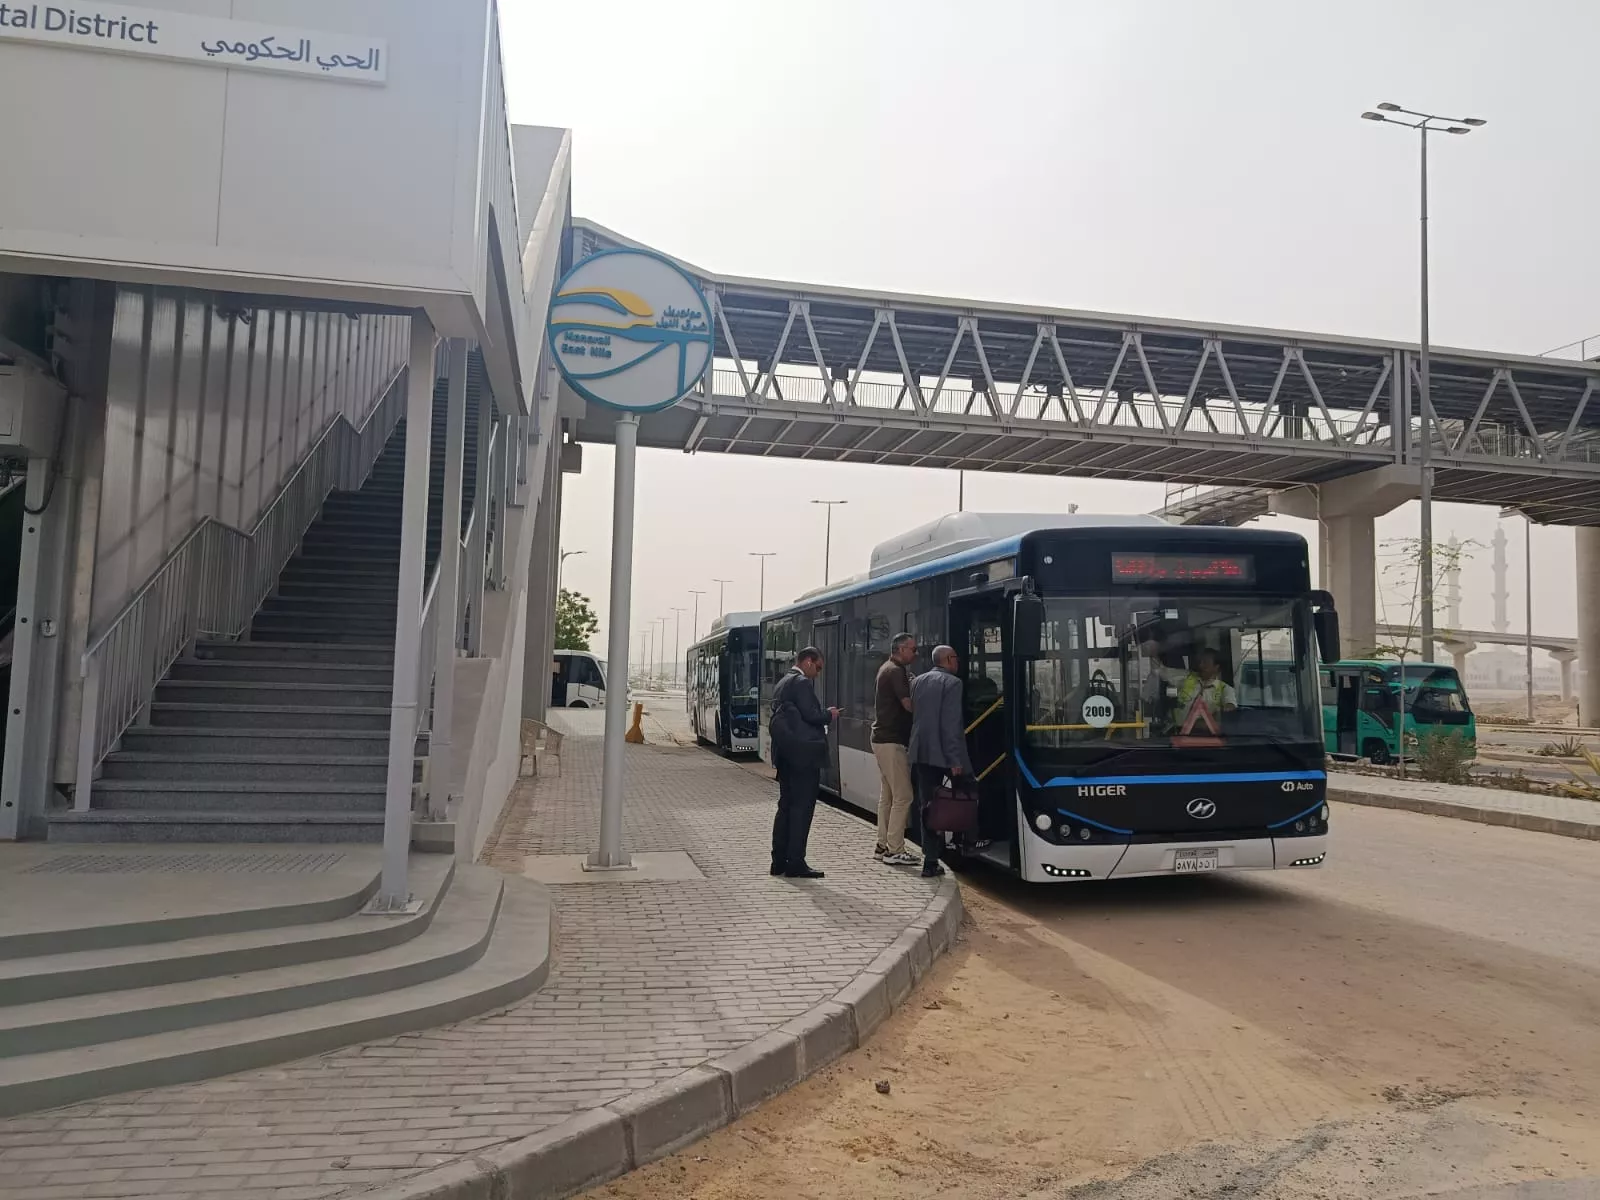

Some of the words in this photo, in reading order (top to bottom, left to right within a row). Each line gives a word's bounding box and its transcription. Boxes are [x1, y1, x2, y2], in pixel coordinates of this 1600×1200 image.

[0, 4, 37, 29] tal
[45, 7, 158, 44] District
[201, 36, 311, 63] الحكومي
[316, 48, 380, 71] الحي
[1085, 705, 1112, 718] 2009
[1078, 785, 1127, 797] HIGER
[1296, 782, 1314, 791] Auto
